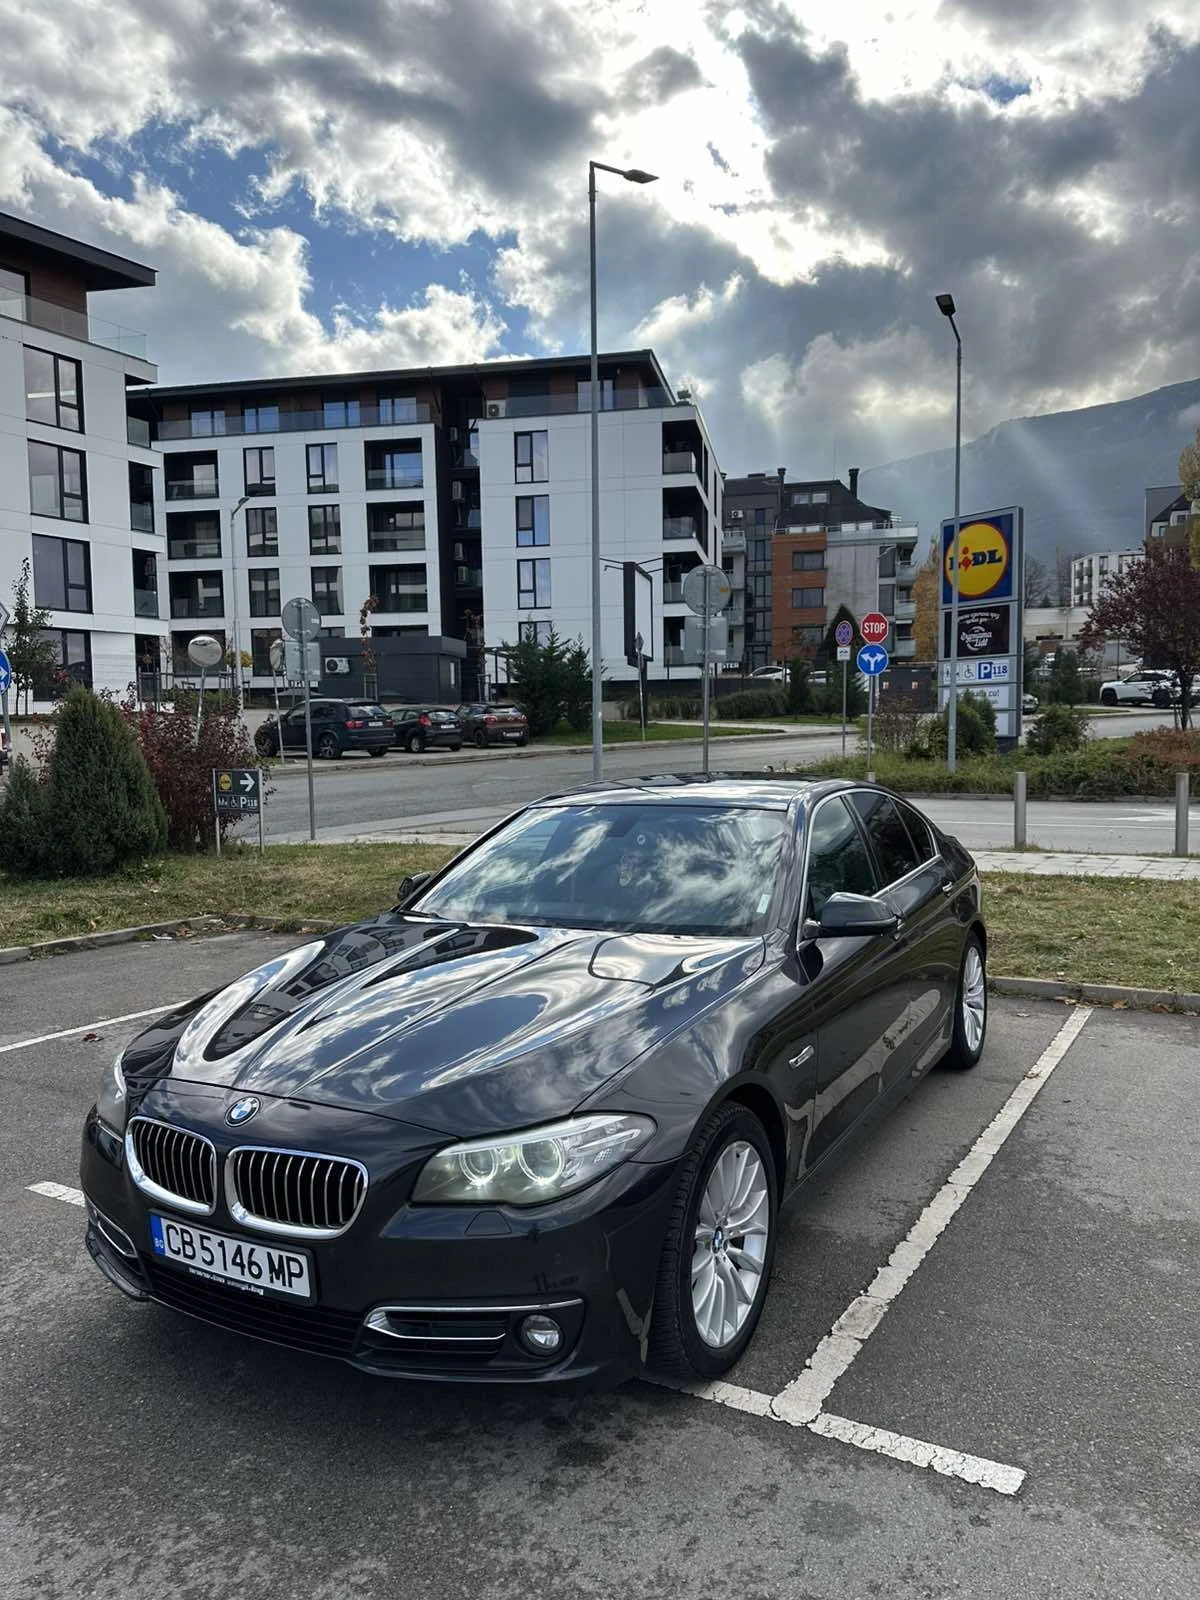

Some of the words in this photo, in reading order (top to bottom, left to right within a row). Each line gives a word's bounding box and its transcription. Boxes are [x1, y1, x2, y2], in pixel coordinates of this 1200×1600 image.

[863, 622, 886, 634] STOP
[980, 663, 991, 679] P
[992, 665, 1008, 675] 118
